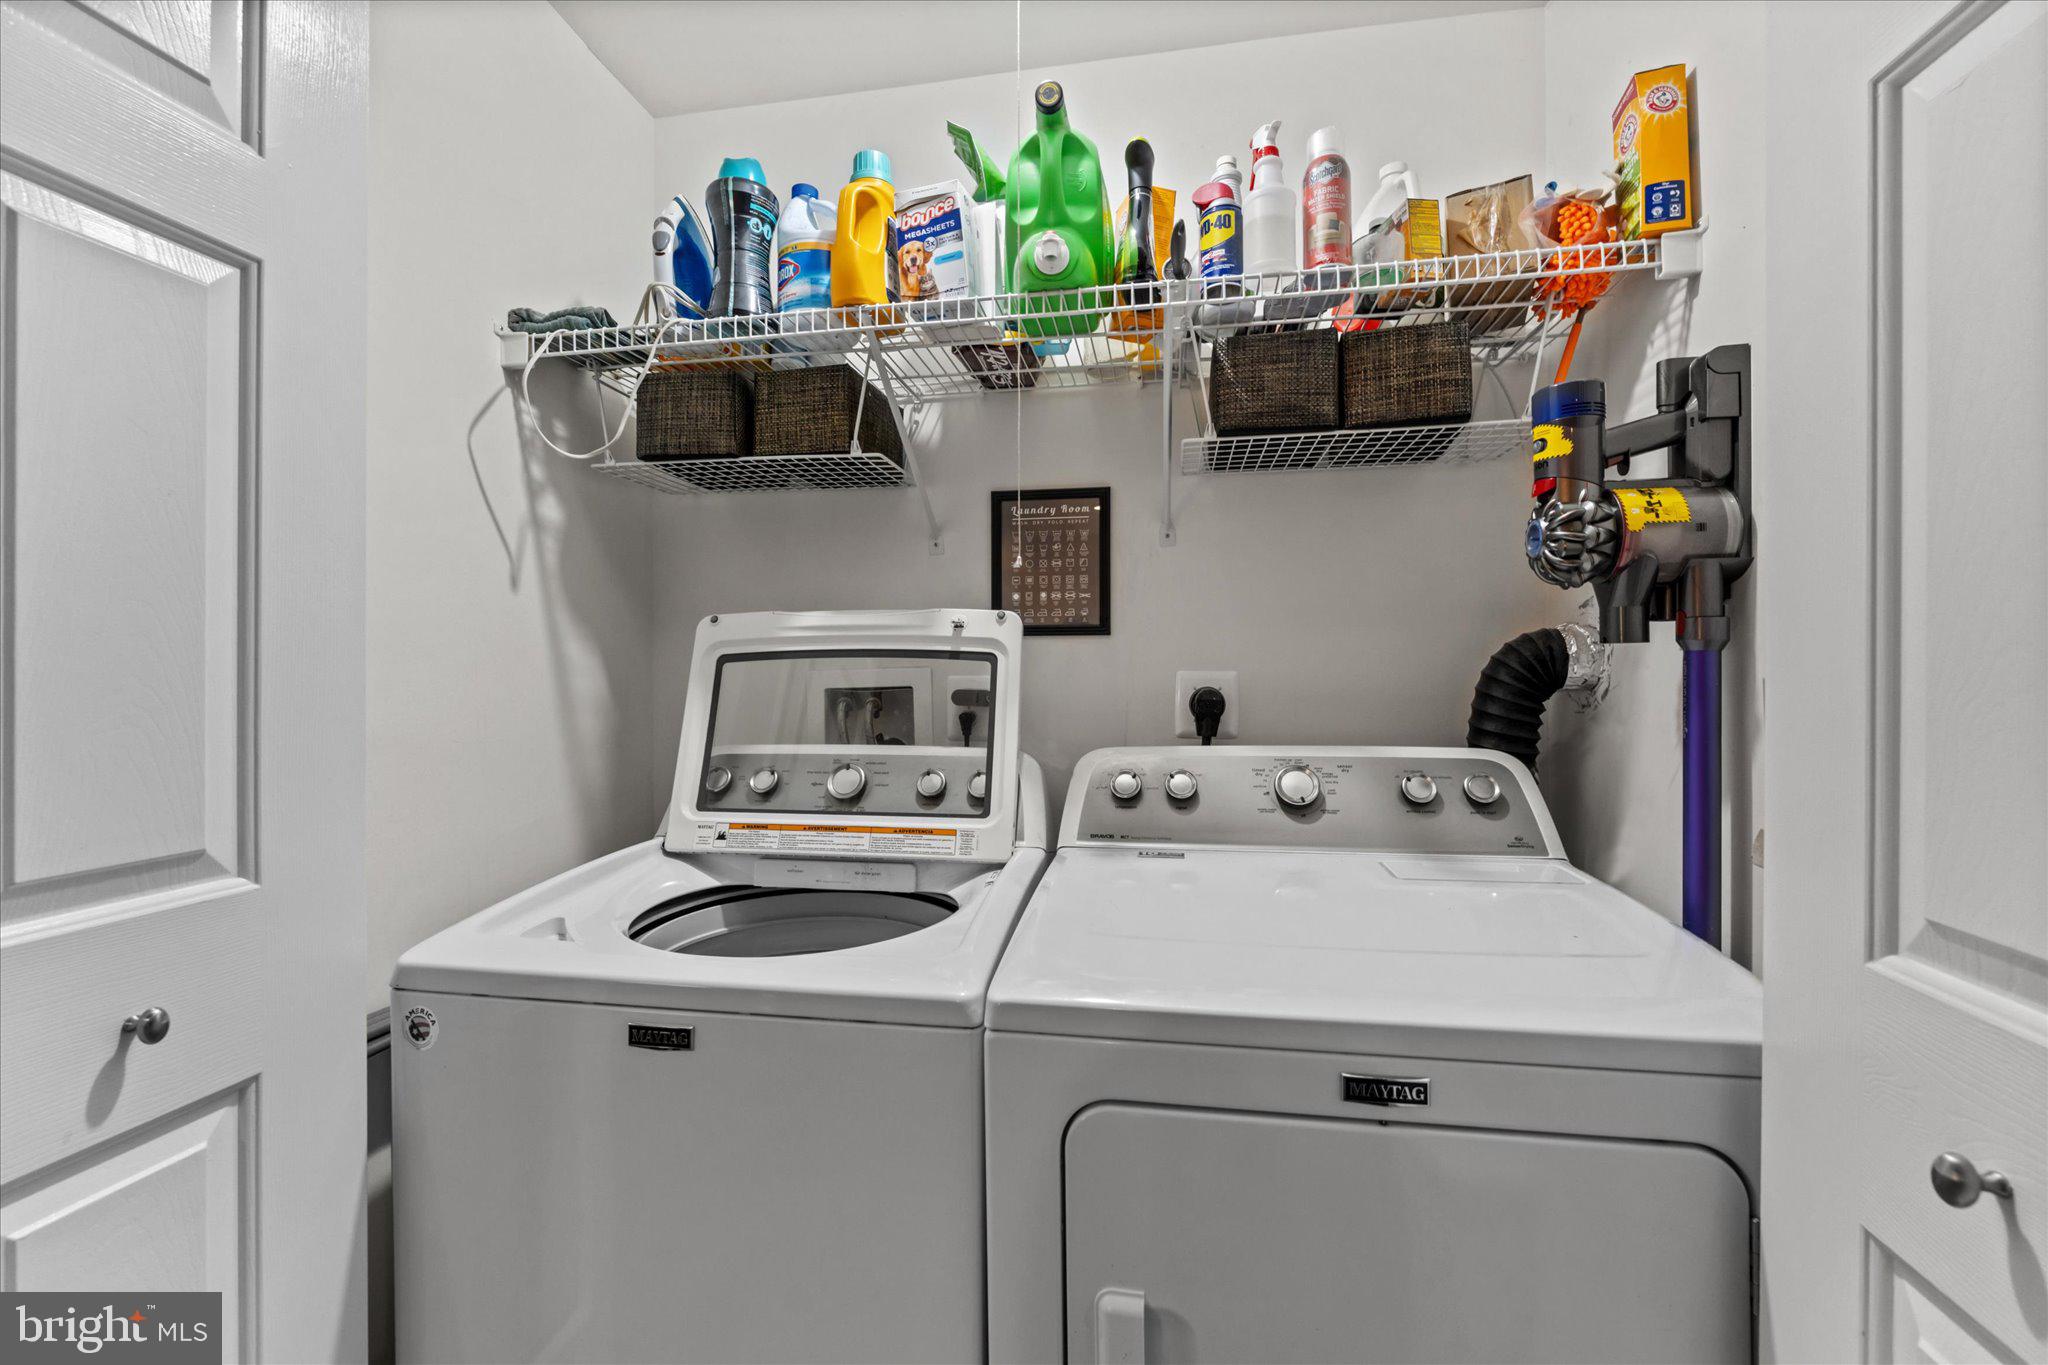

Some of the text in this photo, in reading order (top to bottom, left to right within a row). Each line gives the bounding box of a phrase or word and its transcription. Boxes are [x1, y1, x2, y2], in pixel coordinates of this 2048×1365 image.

[1313, 184, 1339, 197] FABRIC
[901, 196, 955, 231] bounce
[904, 219, 956, 240] MEGASHEETS
[1011, 503, 1090, 518] Laundry Room
[405, 1007, 436, 1027] AMERICA
[631, 1028, 689, 1045] MAYTAG
[1348, 1081, 1426, 1101] MAYTAG
